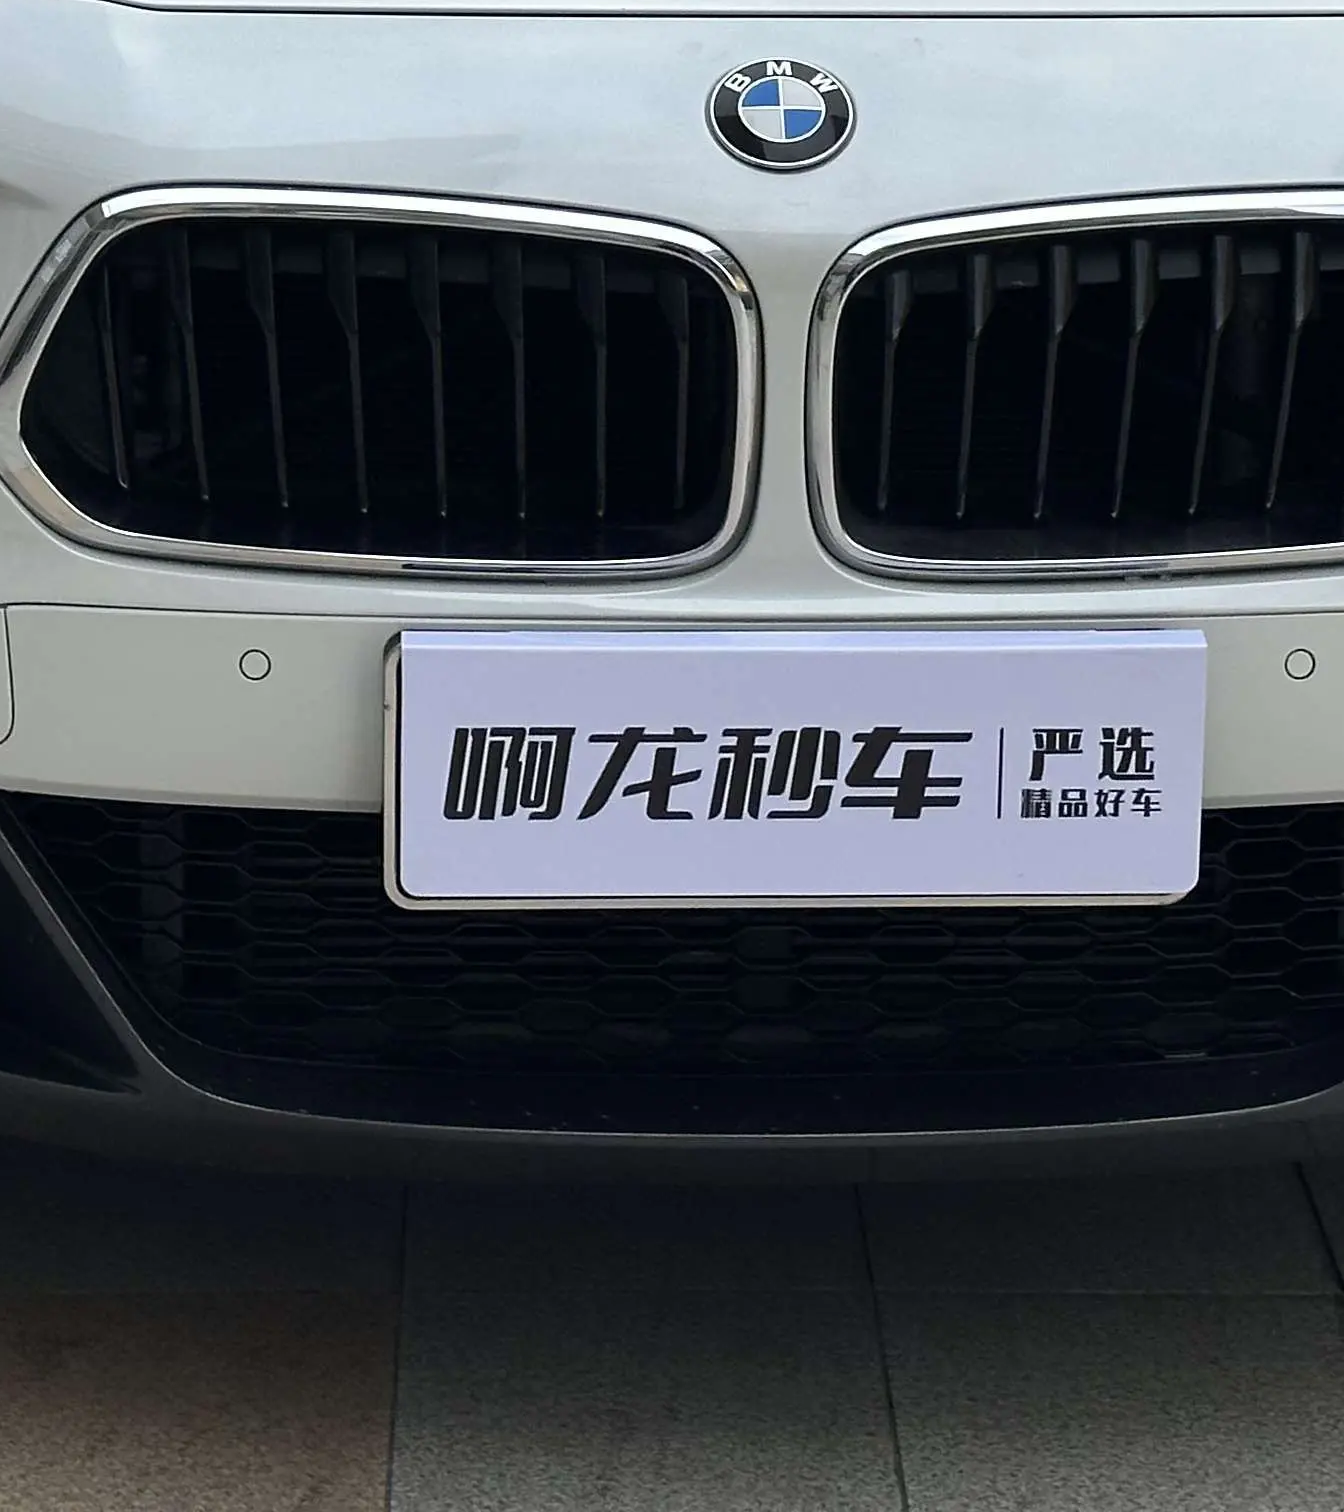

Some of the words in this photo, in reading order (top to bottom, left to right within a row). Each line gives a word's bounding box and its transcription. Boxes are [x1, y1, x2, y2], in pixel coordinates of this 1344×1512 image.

[724, 61, 839, 94] BMW
[442, 726, 974, 821] 啊龙秒车
[1028, 726, 1155, 782] 严选
[1020, 787, 1163, 819] 精品好车
